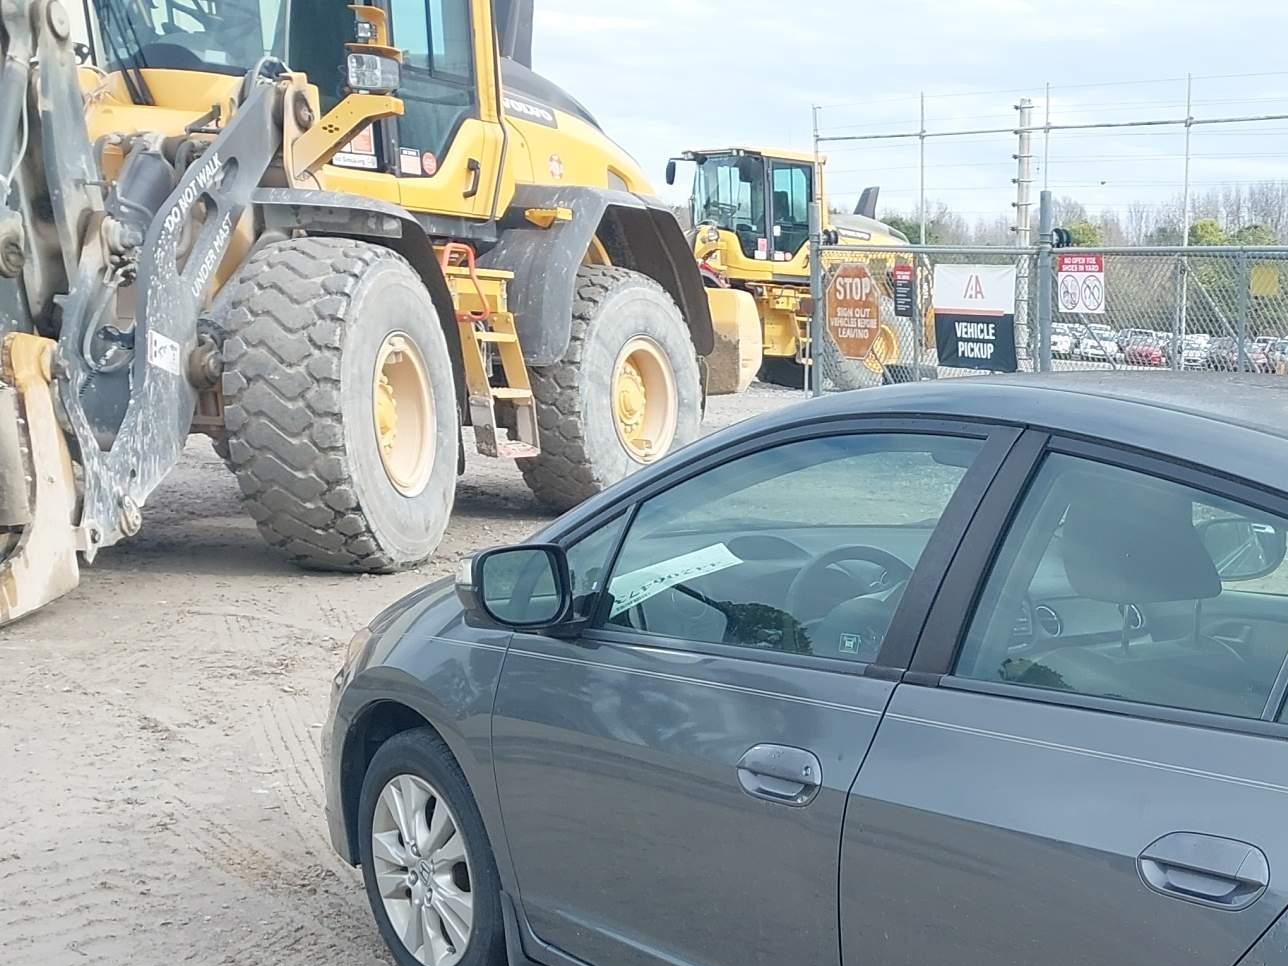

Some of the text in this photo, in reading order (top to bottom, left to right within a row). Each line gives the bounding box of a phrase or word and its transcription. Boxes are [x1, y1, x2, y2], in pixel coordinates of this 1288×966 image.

[165, 152, 223, 233] DO NOT WALK
[191, 211, 234, 297] UNDER MAST
[836, 276, 871, 302] STOP
[836, 307, 871, 318] SIGN OUT
[838, 327, 869, 339] LEAVING
[954, 321, 996, 340] VEHICLE
[958, 341, 994, 360] PICKUP
